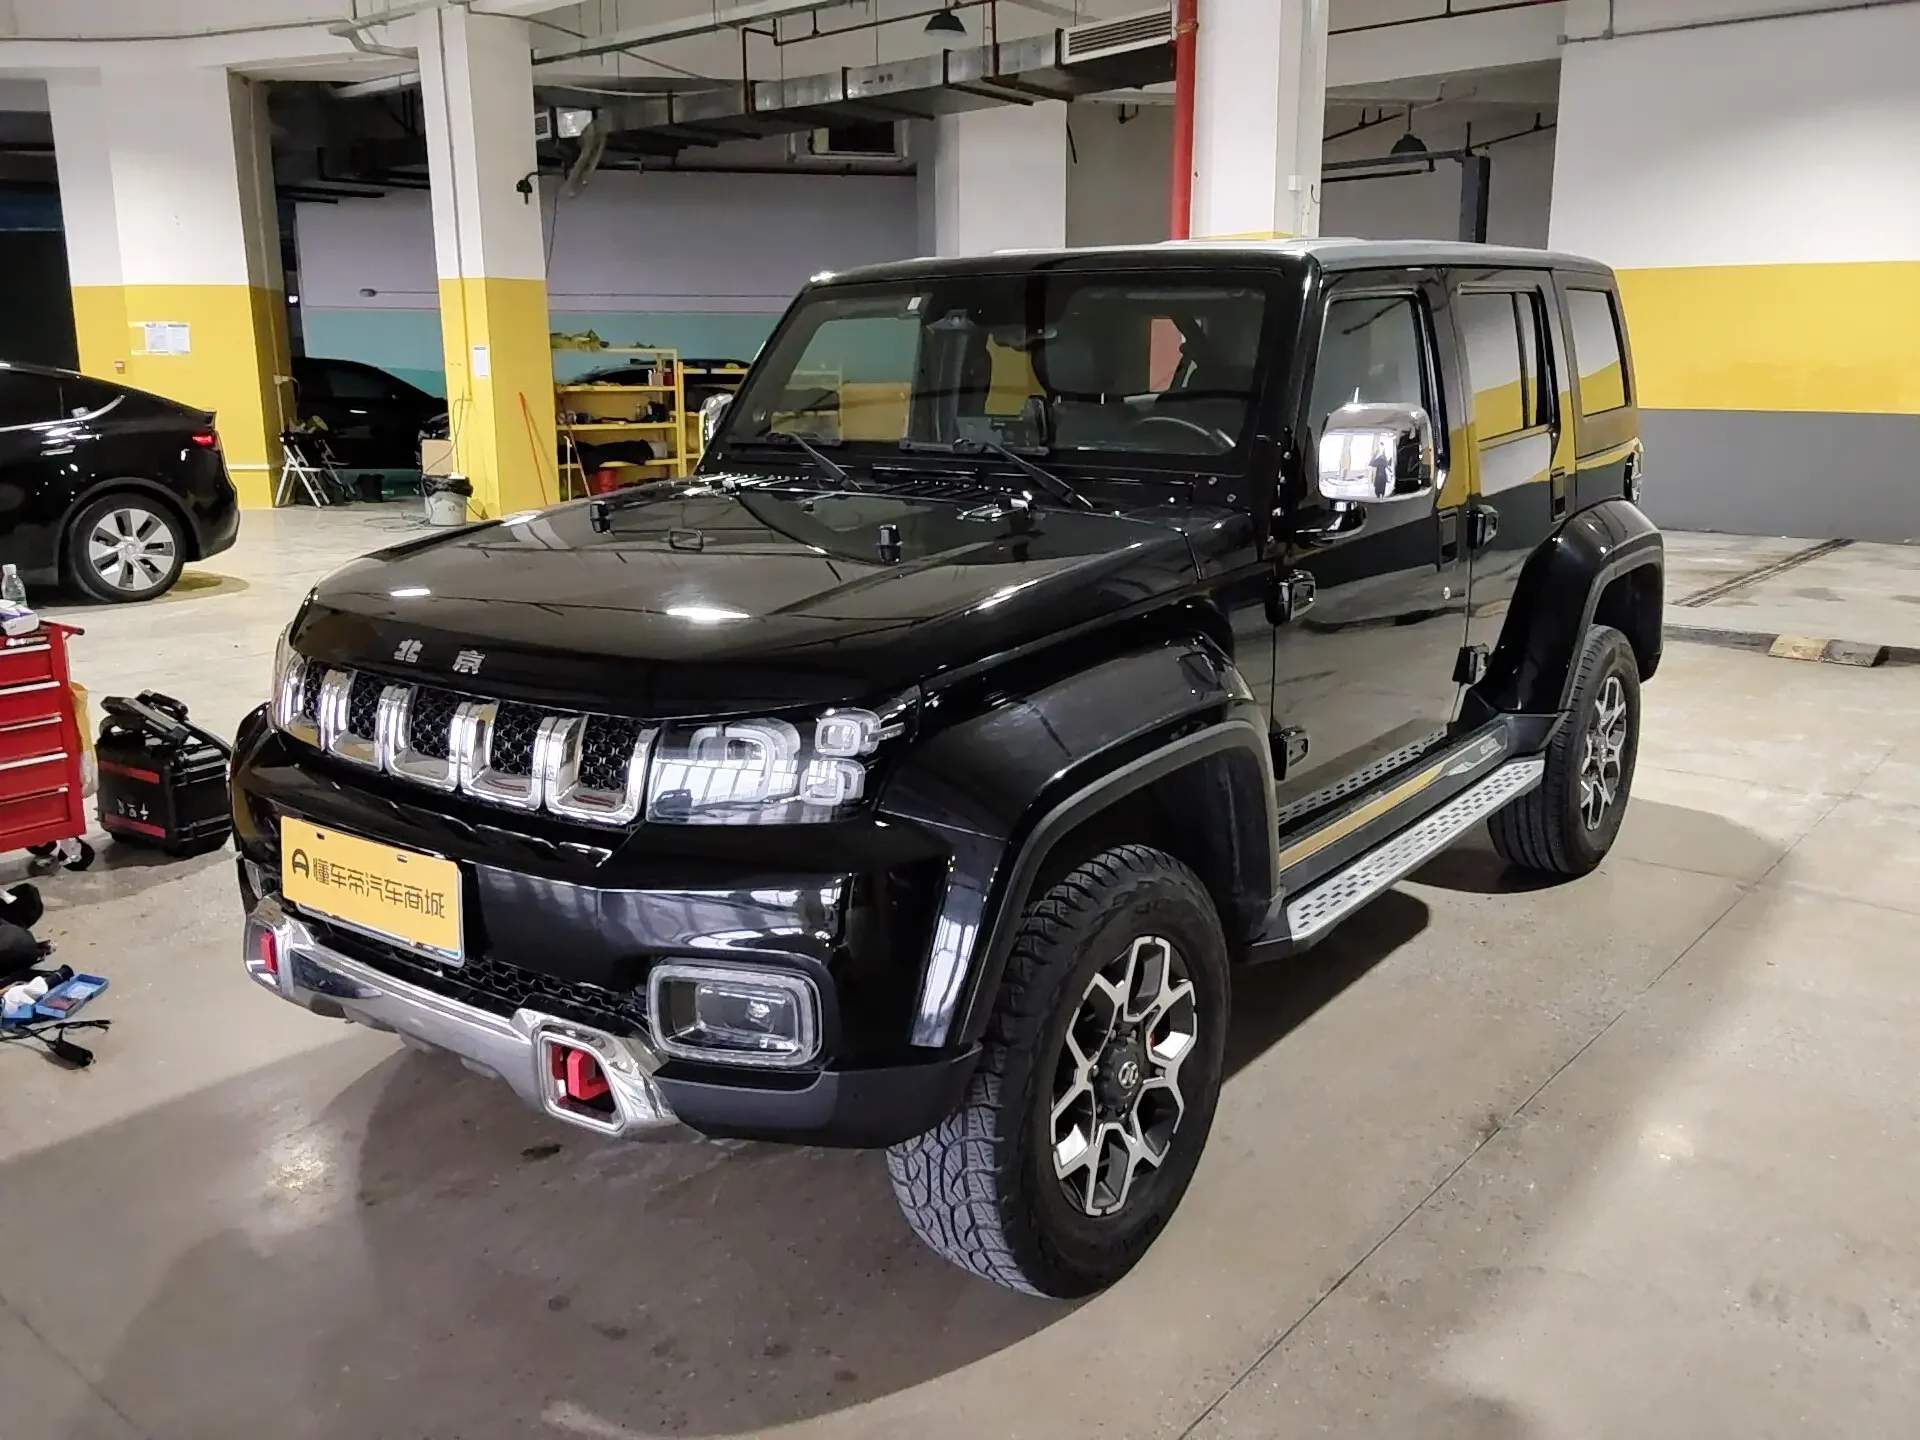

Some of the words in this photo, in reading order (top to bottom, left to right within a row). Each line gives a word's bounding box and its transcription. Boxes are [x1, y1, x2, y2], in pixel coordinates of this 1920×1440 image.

[394, 639, 486, 675] 北京
[312, 857, 445, 919] 懂车帝汽车商城
